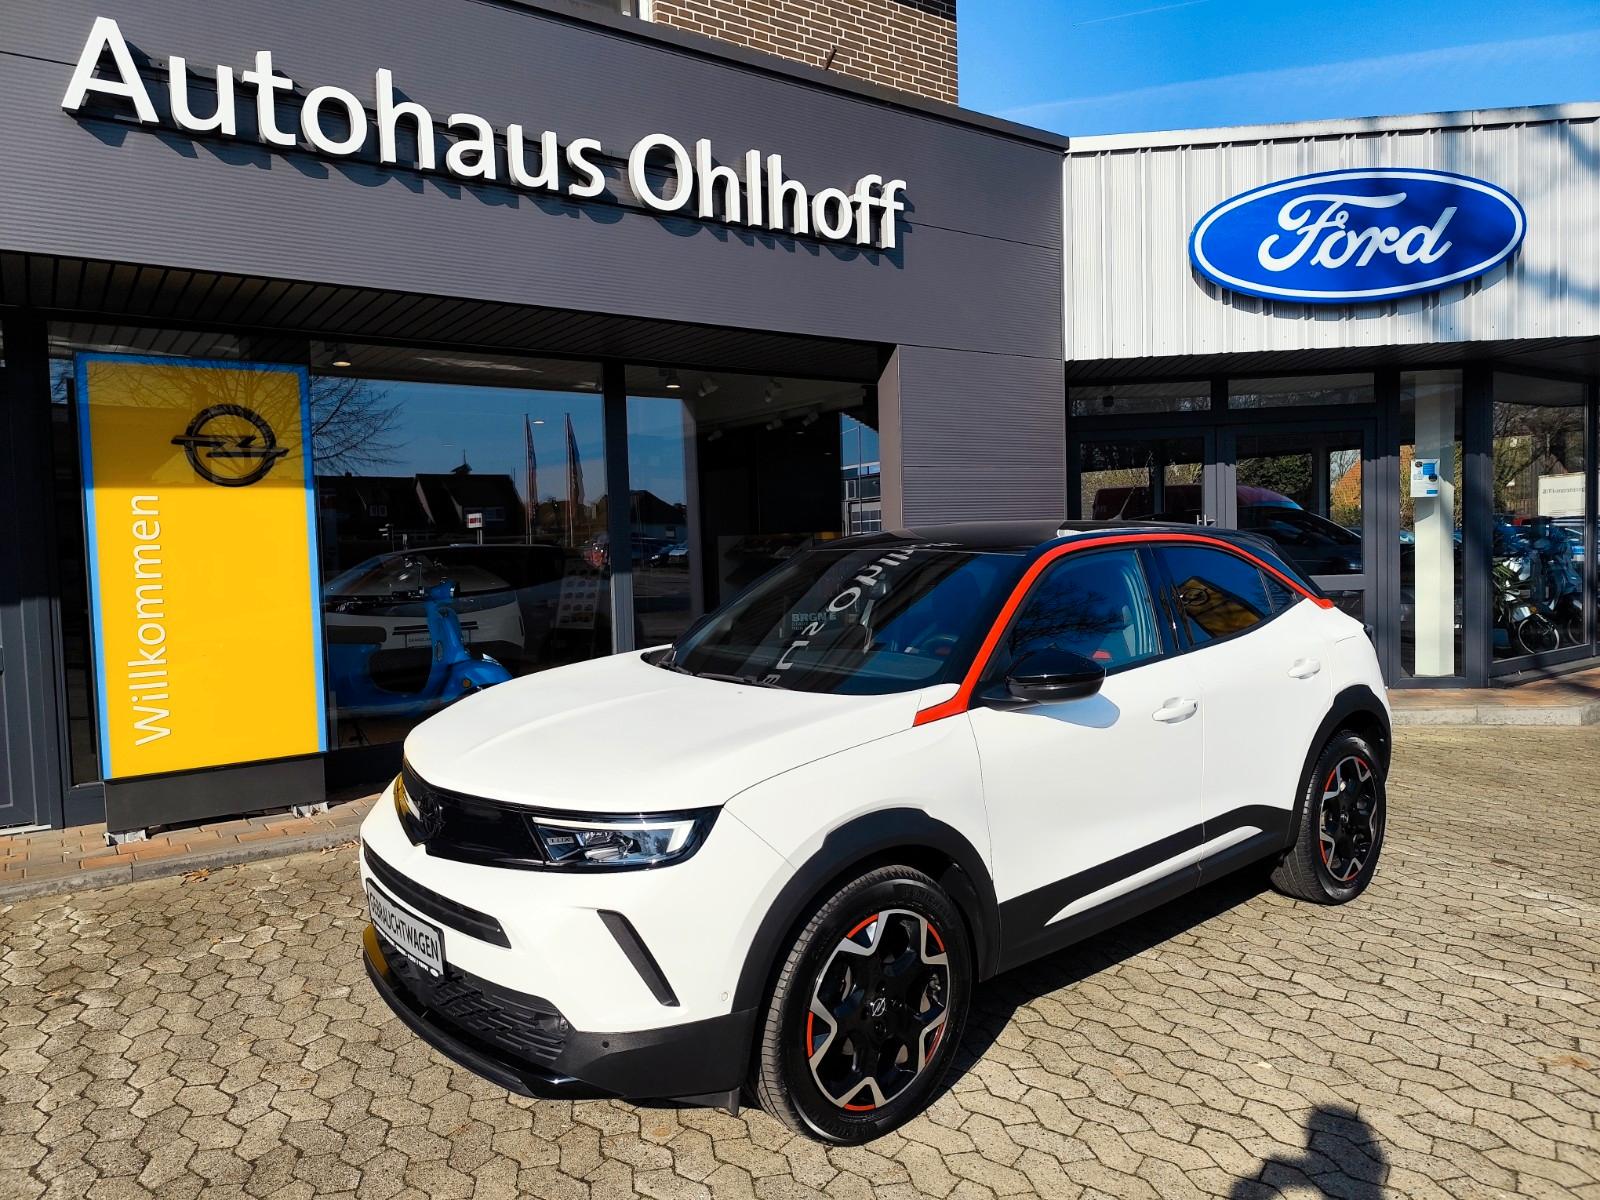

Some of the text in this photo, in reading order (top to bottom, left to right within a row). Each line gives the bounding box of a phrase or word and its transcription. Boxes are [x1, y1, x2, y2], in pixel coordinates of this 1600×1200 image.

[61, 17, 907, 250] Autohaus Ohlhoff
[1257, 191, 1457, 272] Ford
[128, 495, 171, 746] Willkommen
[370, 893, 439, 962] GEBRAUCHTWAGEN
